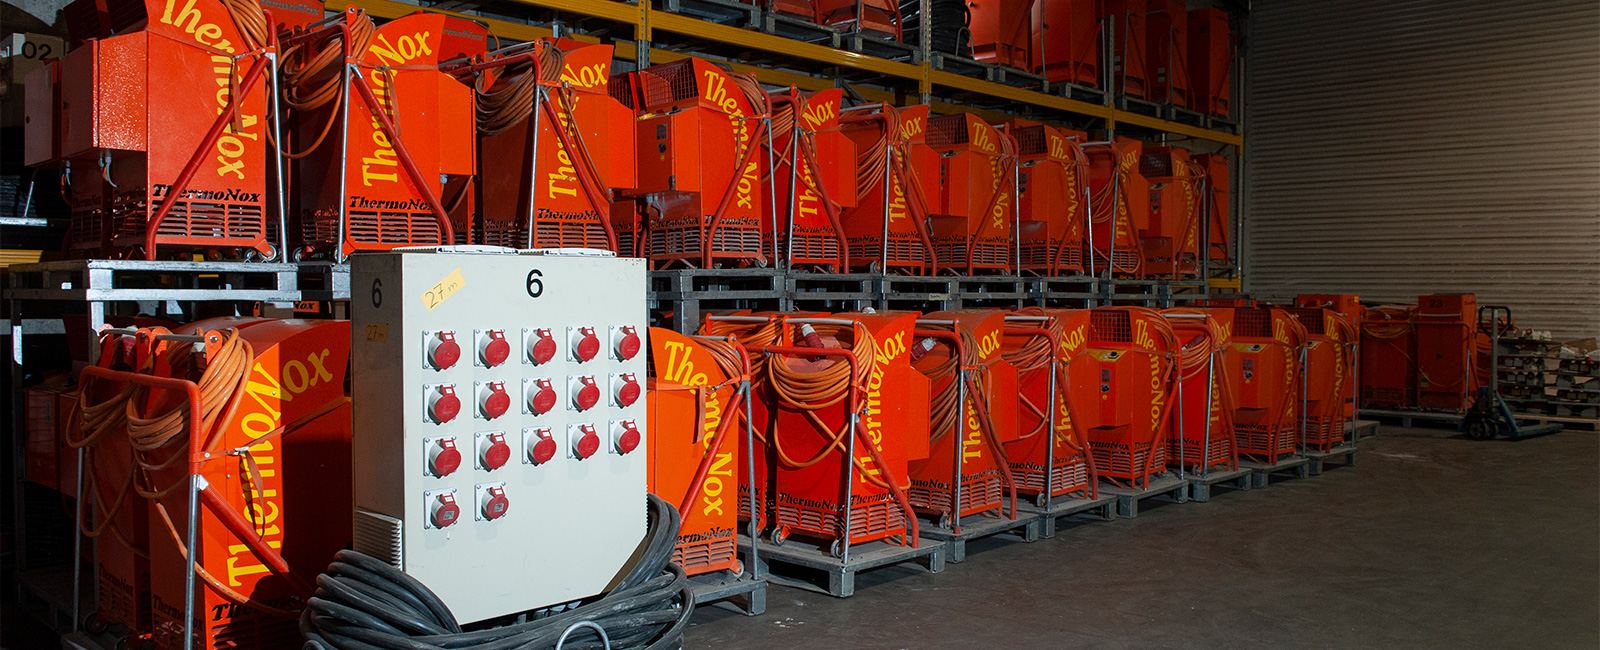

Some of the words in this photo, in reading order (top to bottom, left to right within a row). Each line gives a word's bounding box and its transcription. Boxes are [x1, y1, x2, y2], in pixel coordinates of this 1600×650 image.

[704, 70, 757, 209] ThermNox
[348, 196, 434, 212] ThermoNo
[372, 278, 382, 308] 6
[425, 283, 444, 308] 27
[526, 269, 543, 298] 6
[664, 341, 732, 516] ThemoNox
